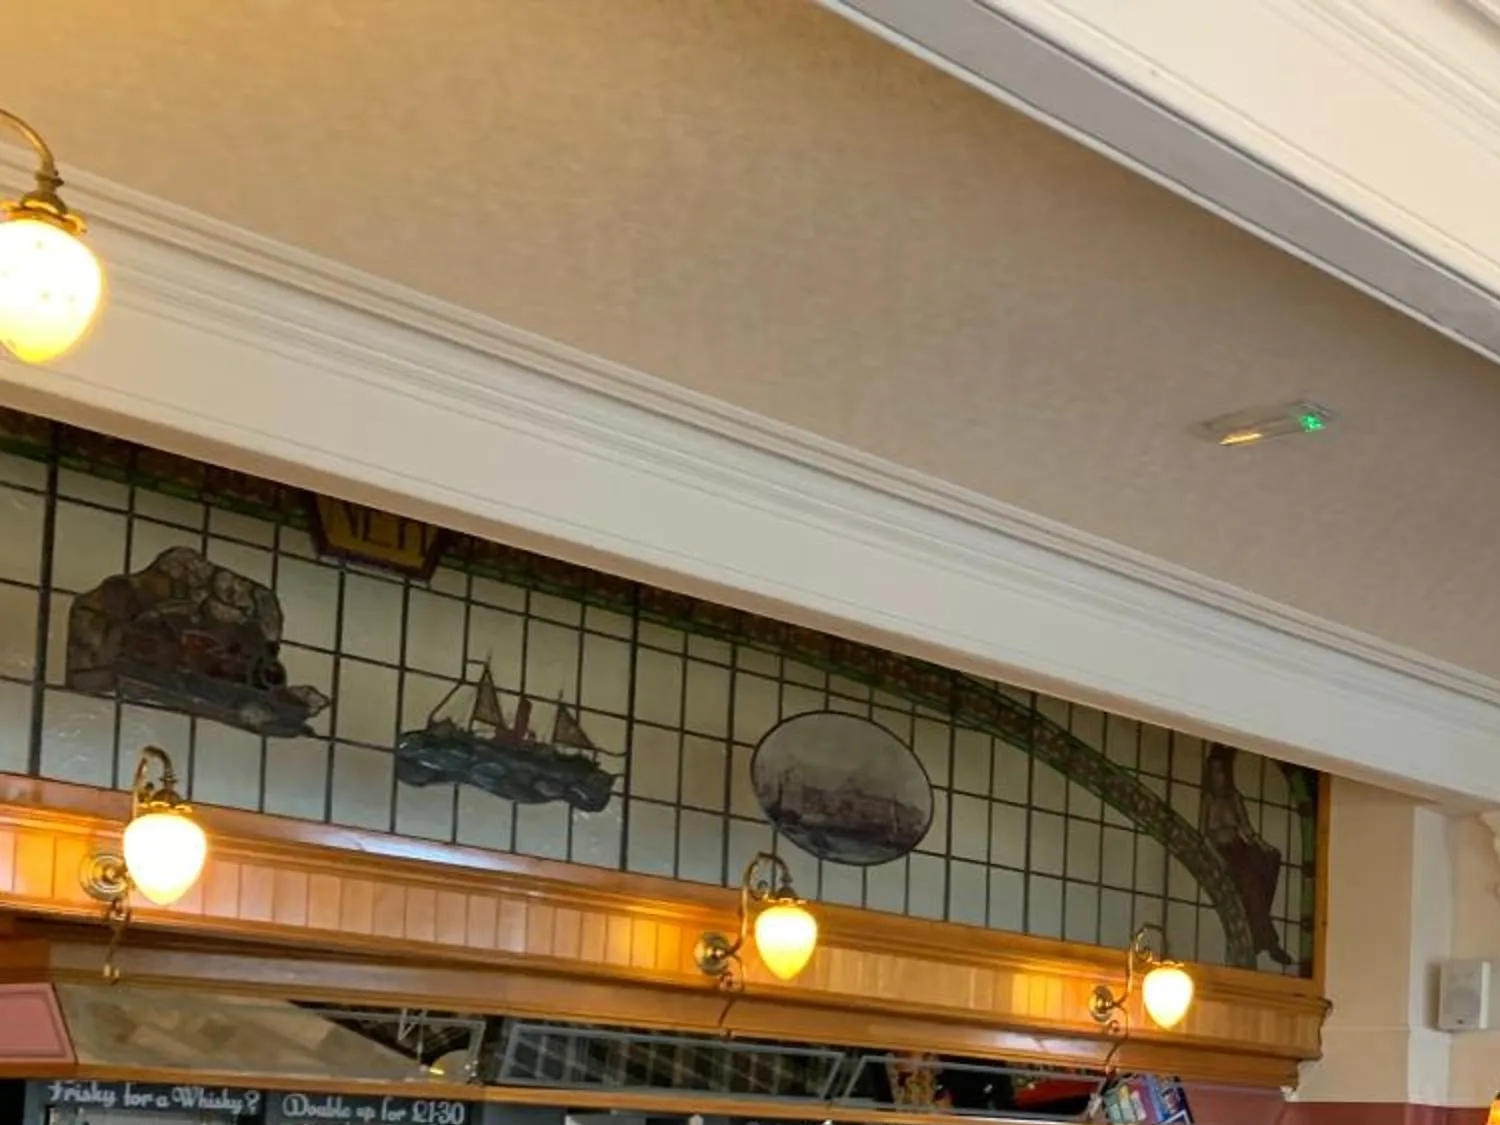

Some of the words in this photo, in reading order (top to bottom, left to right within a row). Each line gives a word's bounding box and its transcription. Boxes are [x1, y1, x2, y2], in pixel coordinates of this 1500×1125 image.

[123, 1082, 154, 1107] for
[156, 1094, 170, 1107] a
[282, 1093, 352, 1118] Double
[380, 1095, 407, 1121] for
